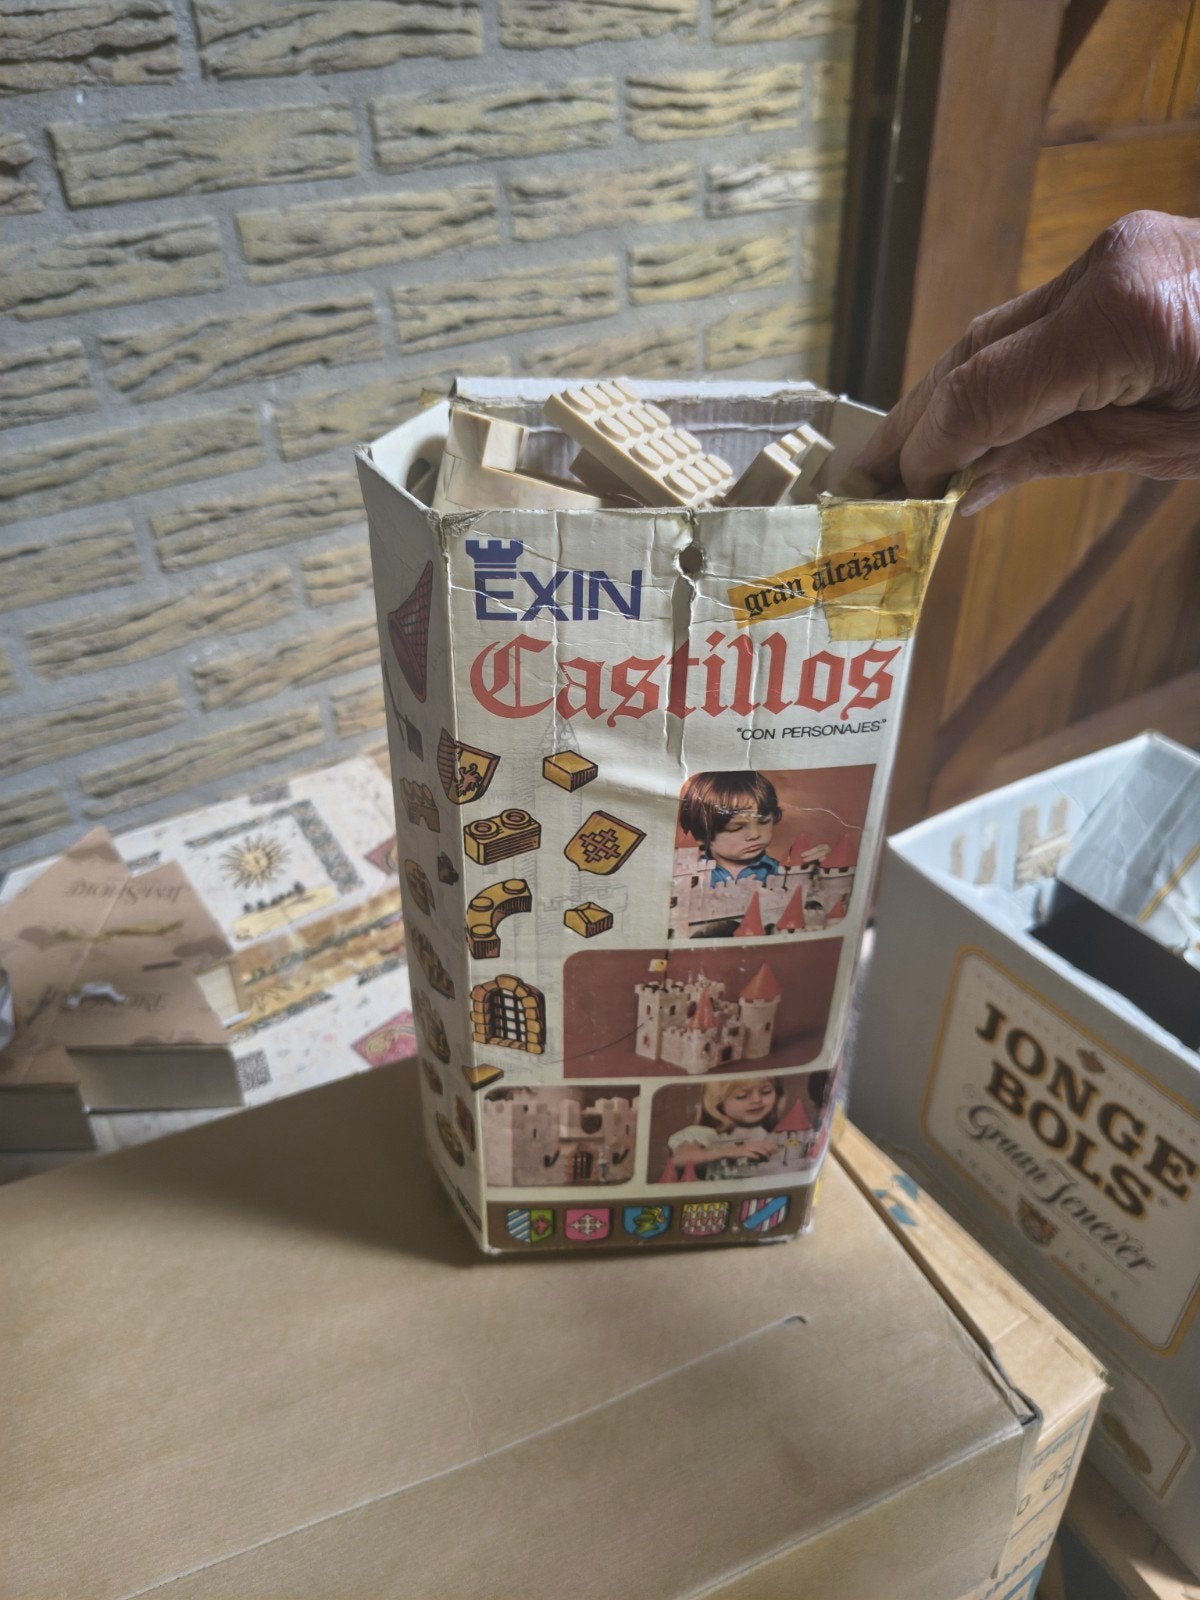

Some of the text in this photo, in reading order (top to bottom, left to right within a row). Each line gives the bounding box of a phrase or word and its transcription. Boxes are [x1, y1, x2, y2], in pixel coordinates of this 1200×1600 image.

[474, 569, 643, 622] EXIN
[744, 577, 805, 617] gran
[469, 631, 903, 728] Castillos
[975, 1001, 1200, 1203] JONGE
[985, 1059, 1154, 1222] BOLS
